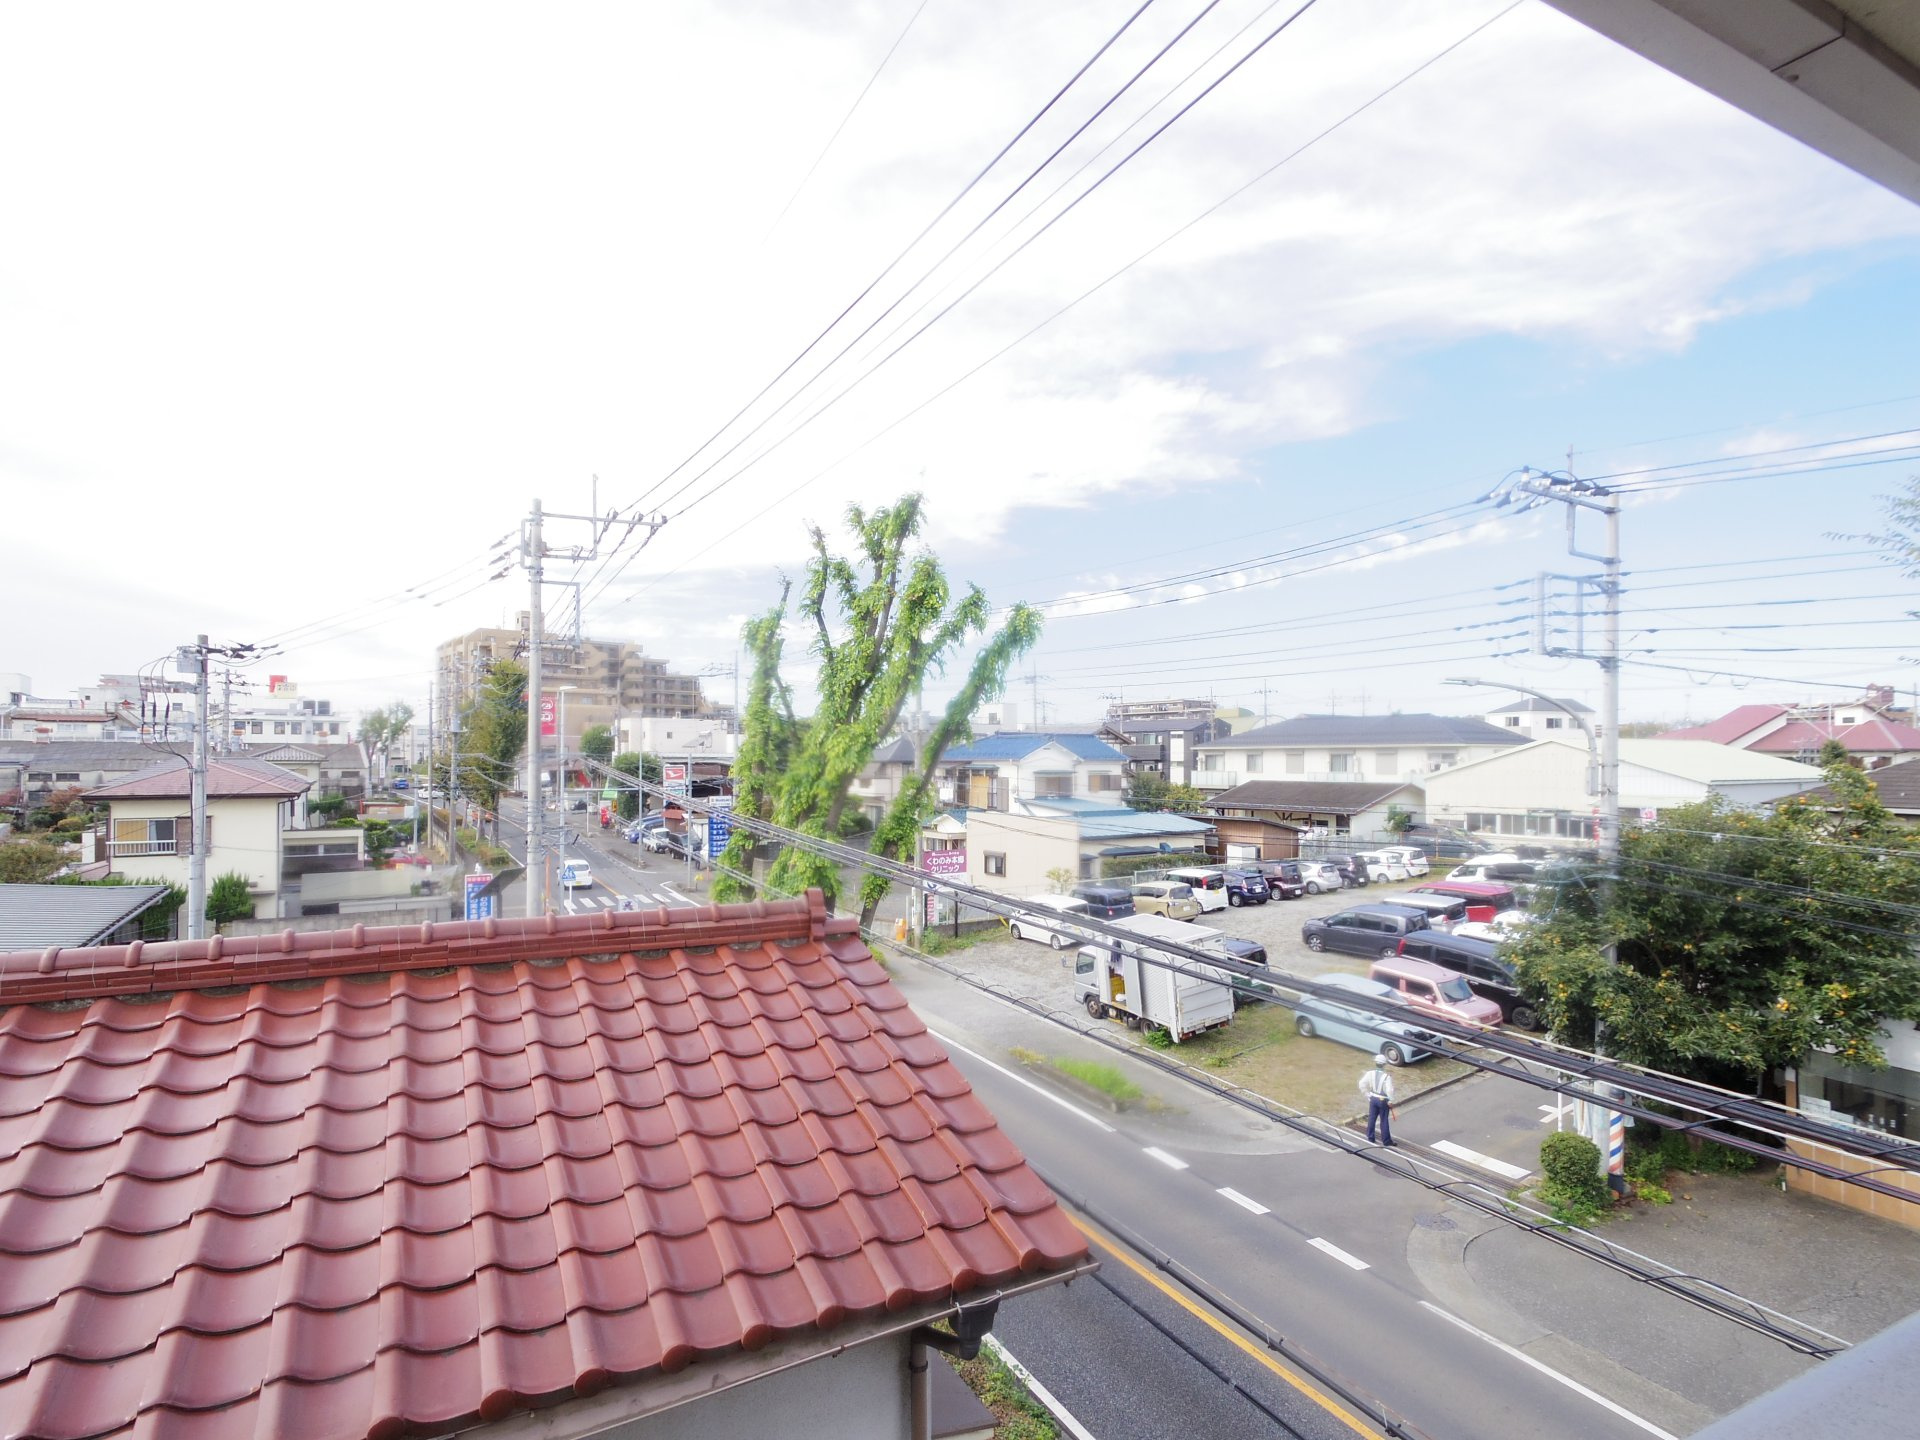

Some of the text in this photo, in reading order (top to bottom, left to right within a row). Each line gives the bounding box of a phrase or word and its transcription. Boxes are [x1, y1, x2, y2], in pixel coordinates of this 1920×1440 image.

[931, 865, 960, 874] クリニック
